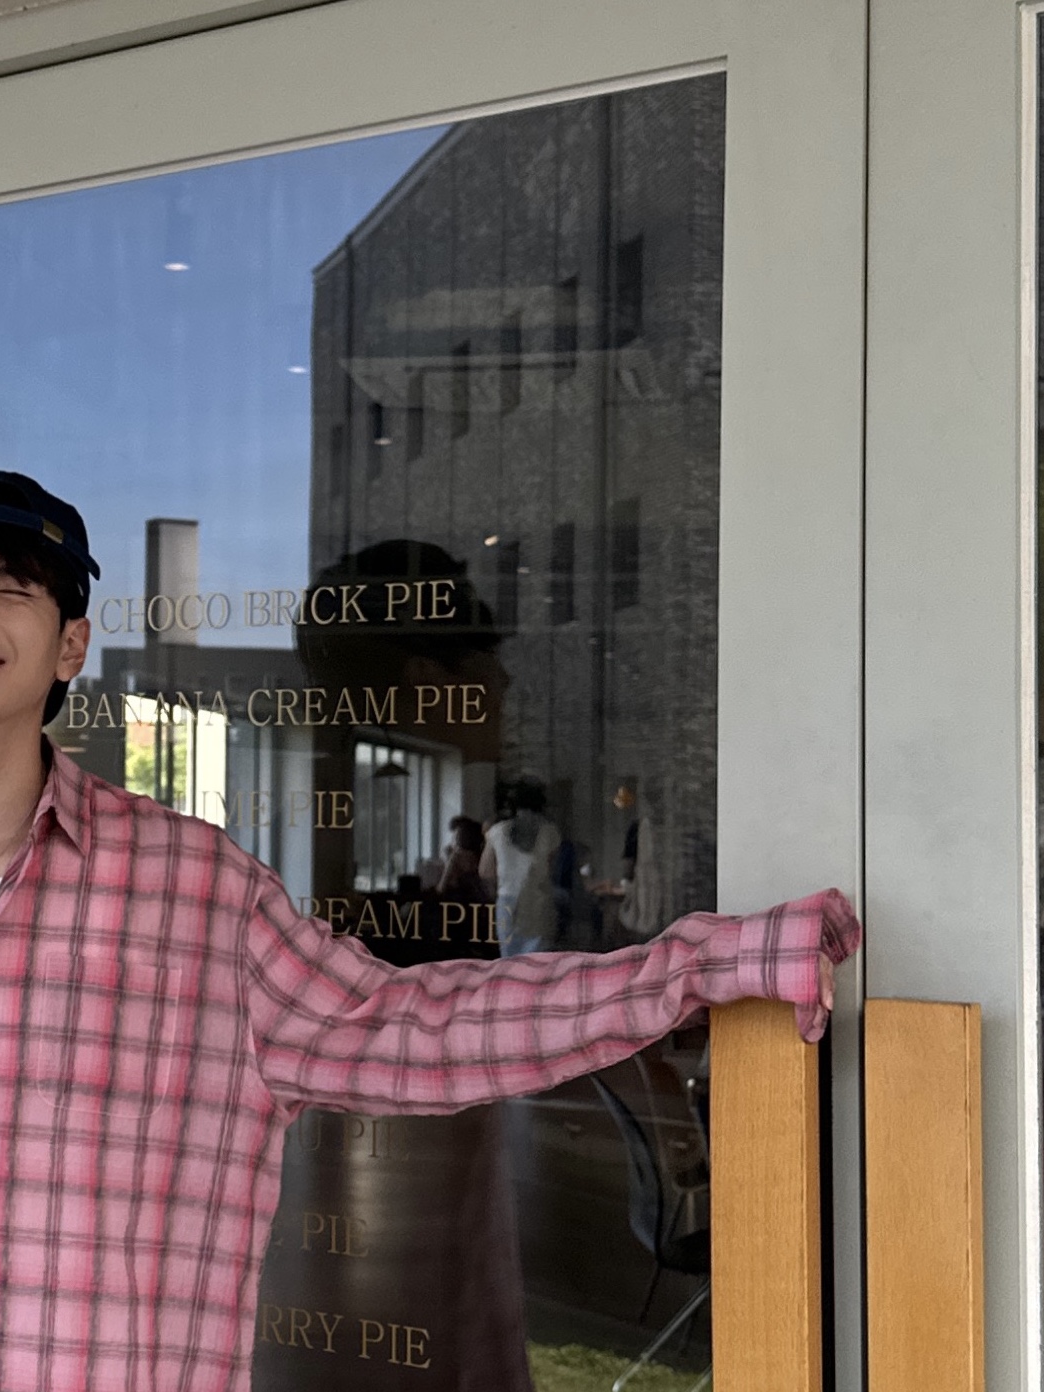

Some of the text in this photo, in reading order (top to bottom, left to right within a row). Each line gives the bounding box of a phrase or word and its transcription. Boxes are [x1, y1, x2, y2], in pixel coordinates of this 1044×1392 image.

[99, 579, 457, 635] CHOCO BRICK PIE
[67, 684, 488, 730] BANANA CREAM PIE
[289, 790, 355, 829] PIE
[438, 900, 514, 944] PIE
[300, 1211, 370, 1259] PIE
[357, 1317, 432, 1371] PIE
